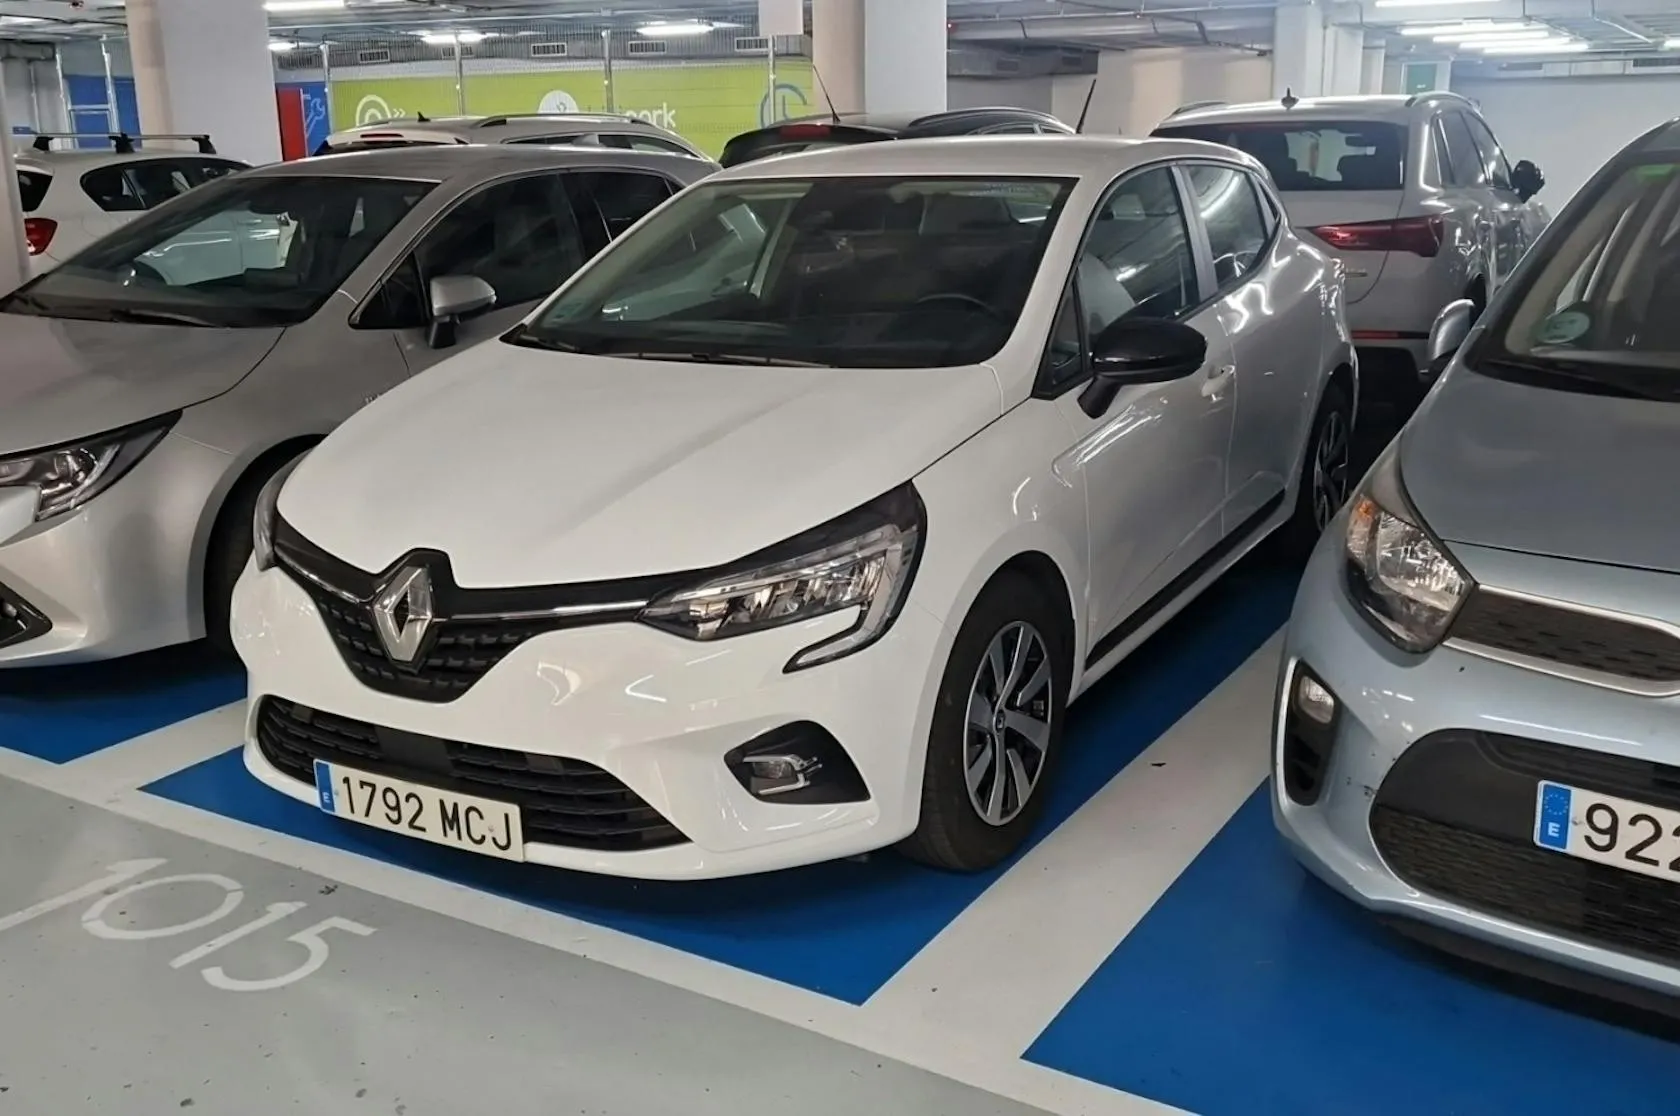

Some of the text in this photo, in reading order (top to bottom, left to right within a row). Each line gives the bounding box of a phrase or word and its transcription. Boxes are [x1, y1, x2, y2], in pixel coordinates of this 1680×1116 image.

[342, 776, 427, 833] 1792
[439, 798, 512, 851] MCJ
[1547, 802, 1680, 872] E 92
[0, 857, 378, 991] 1015
